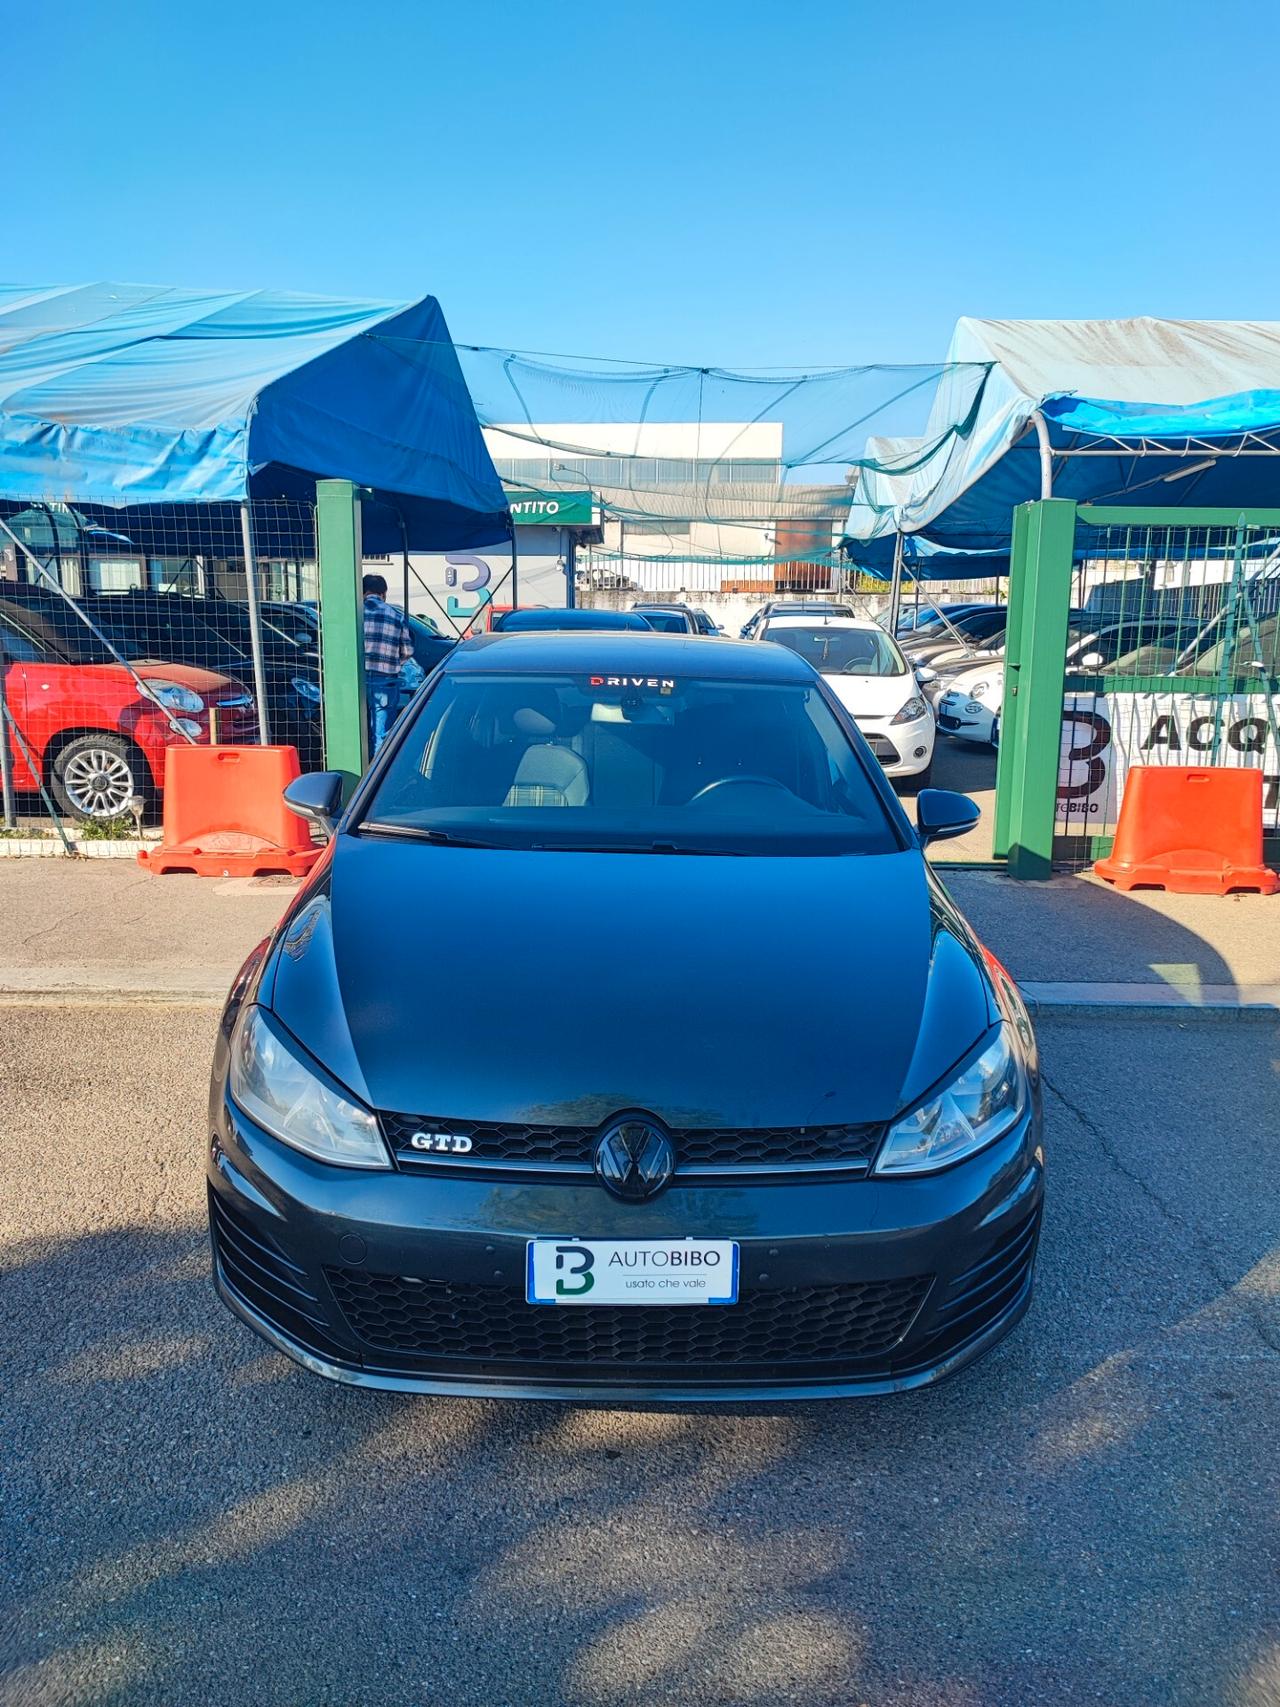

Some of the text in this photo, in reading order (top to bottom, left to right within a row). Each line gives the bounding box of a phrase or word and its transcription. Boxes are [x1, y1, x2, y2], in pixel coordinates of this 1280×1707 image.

[510, 501, 559, 515] NTITO
[591, 676, 675, 688] DRIVEN
[411, 1132, 473, 1153] GTD
[608, 1250, 721, 1267] AUTOBIBO
[625, 1278, 706, 1289] usato che vale
